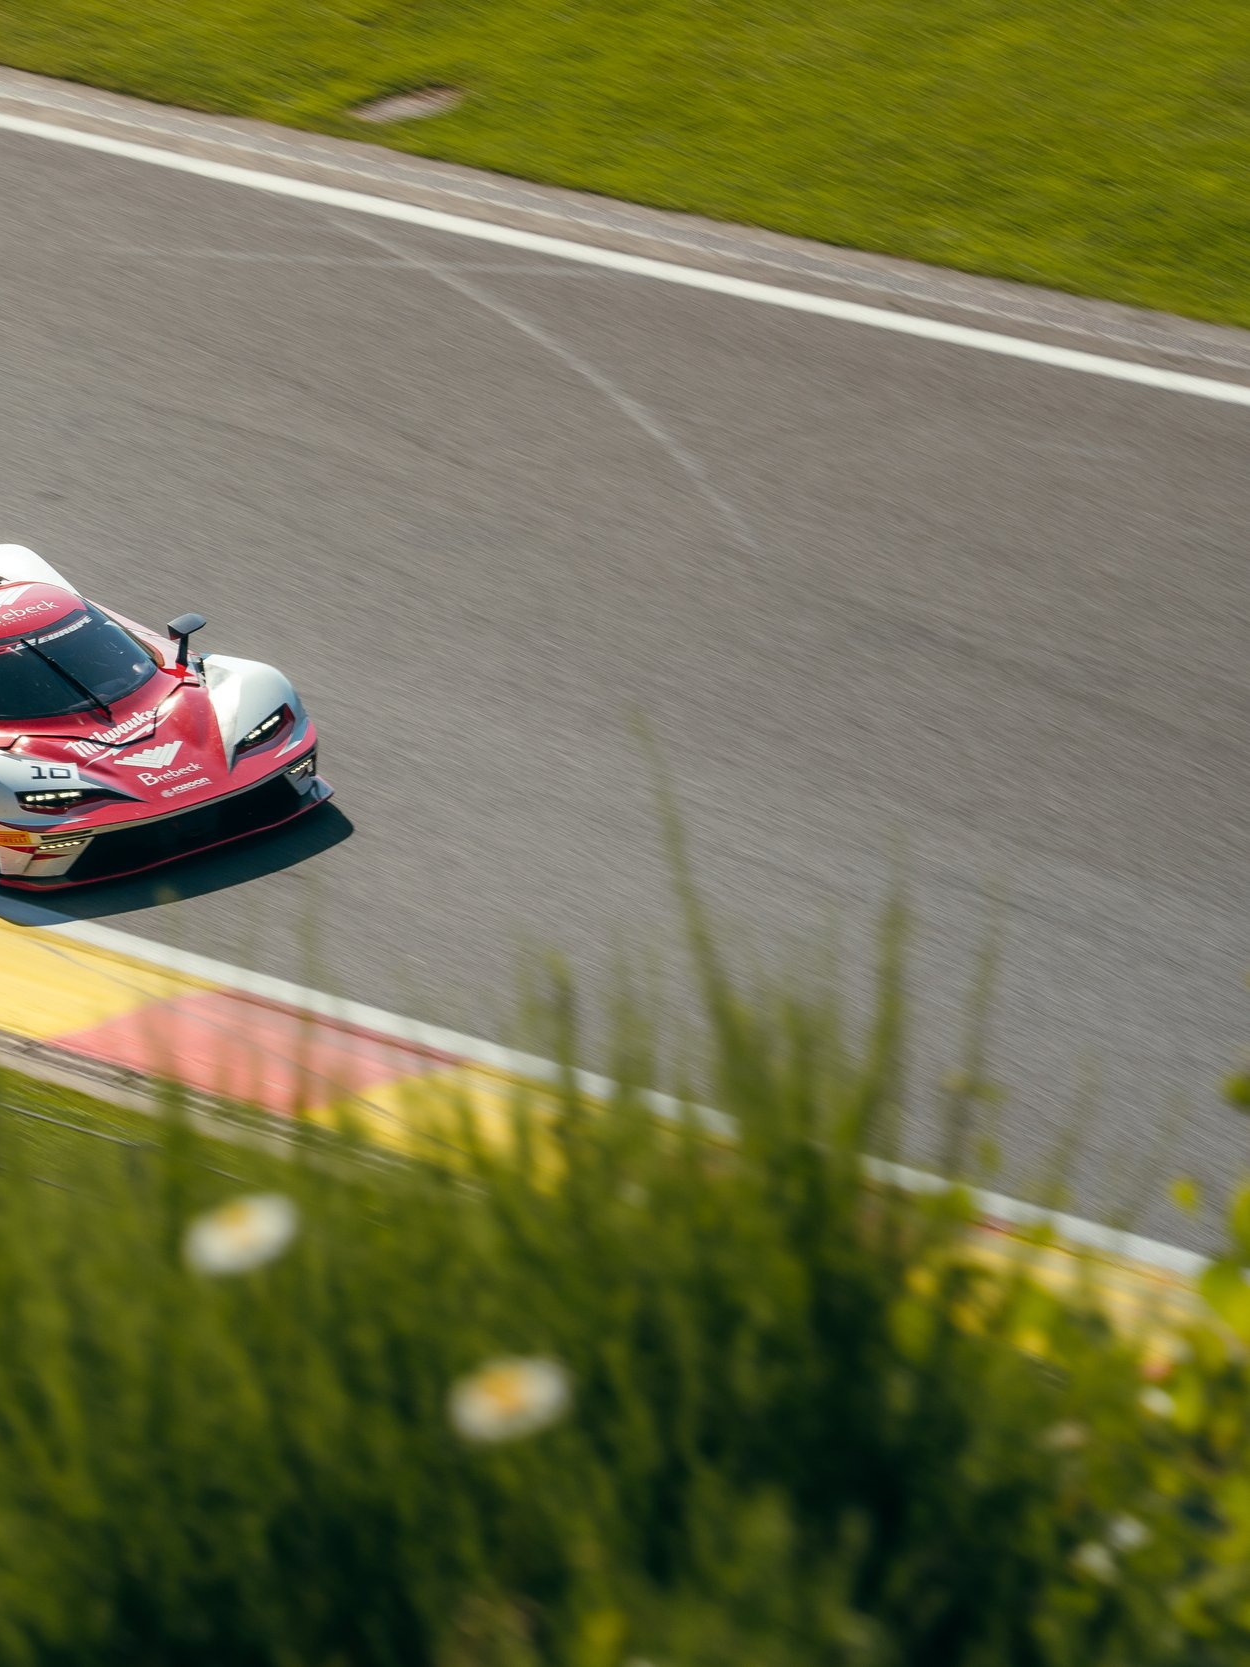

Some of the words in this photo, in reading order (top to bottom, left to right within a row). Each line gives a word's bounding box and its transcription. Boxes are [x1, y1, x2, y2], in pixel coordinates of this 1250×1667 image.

[38, 615, 93, 644] EUROPE
[63, 706, 164, 758] Milwauke
[31, 765, 71, 780] 10
[137, 763, 203, 786] Brebeck
[171, 777, 211, 793] razoon
